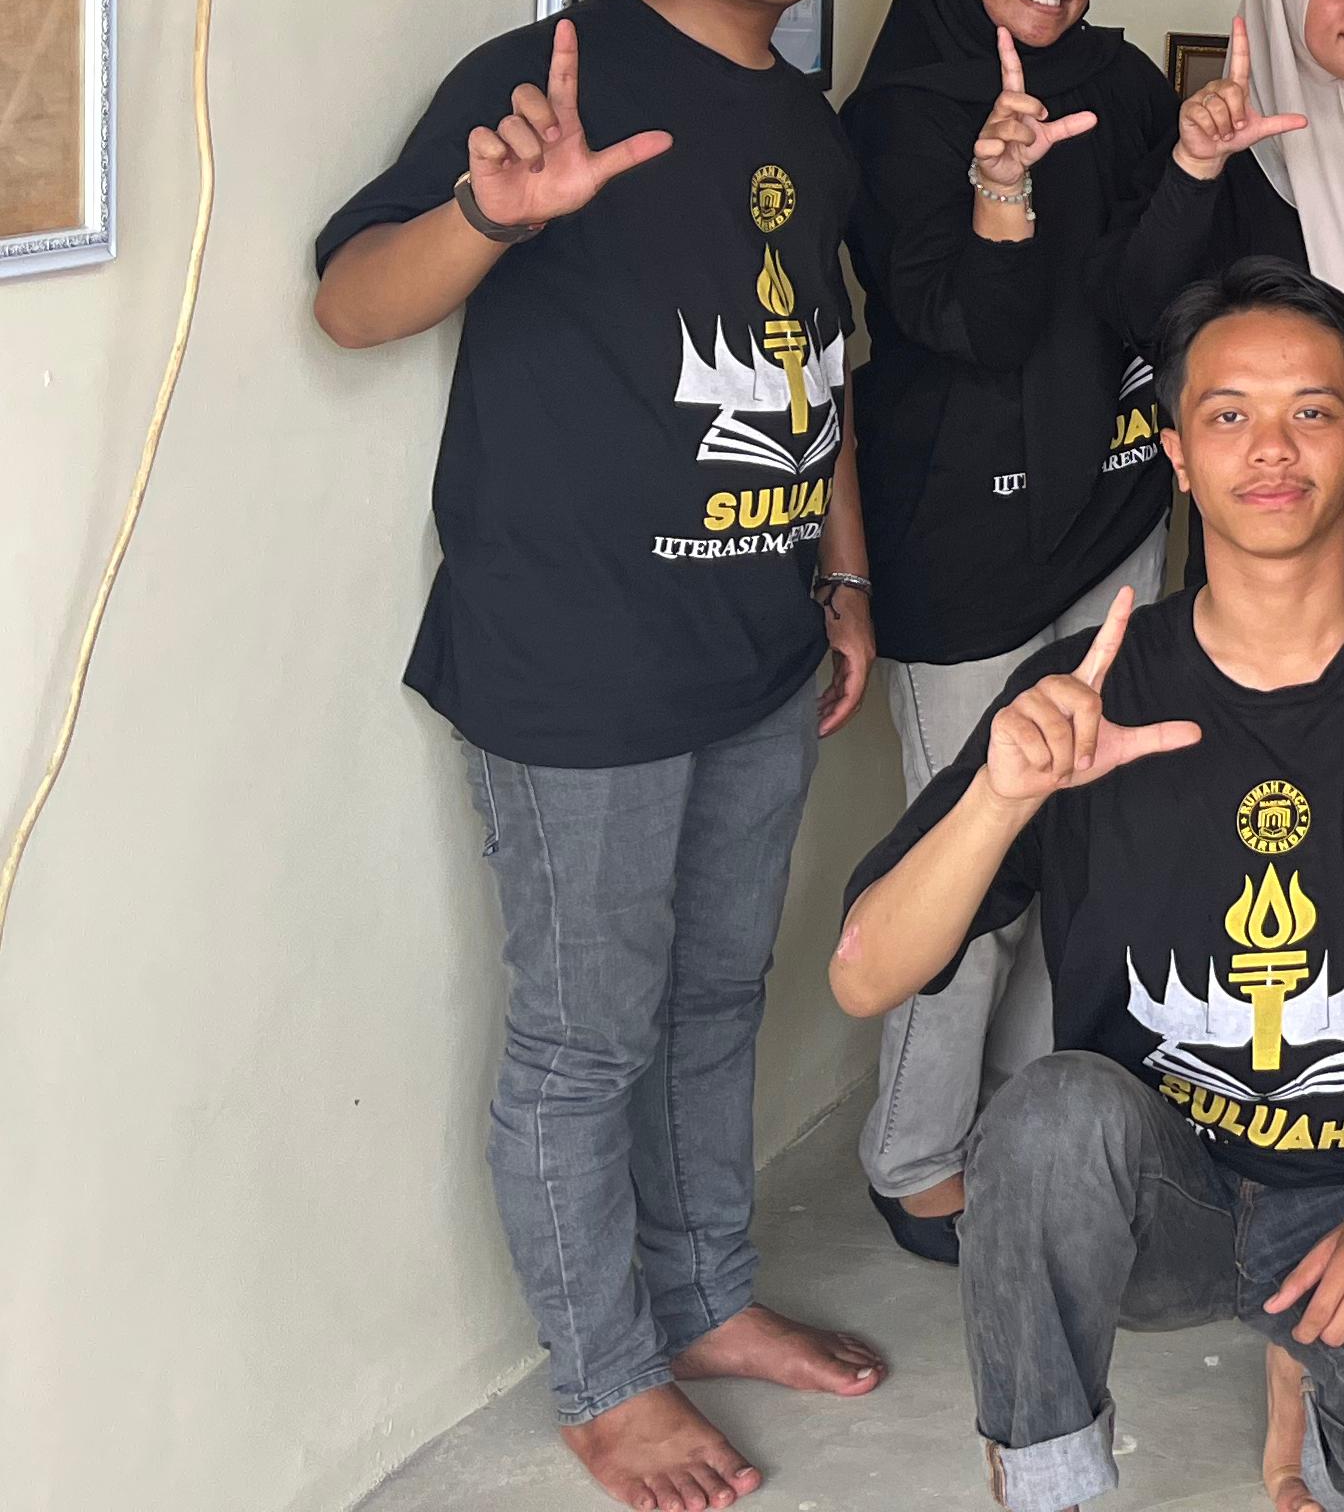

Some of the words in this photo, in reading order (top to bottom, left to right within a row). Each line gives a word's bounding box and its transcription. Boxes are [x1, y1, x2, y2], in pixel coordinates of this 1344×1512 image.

[704, 478, 832, 531] SULUA
[652, 536, 760, 559] LITERASI
[1240, 780, 1279, 814] RUMAH
[1281, 782, 1309, 812] BACA
[1240, 827, 1308, 852] MARENDA
